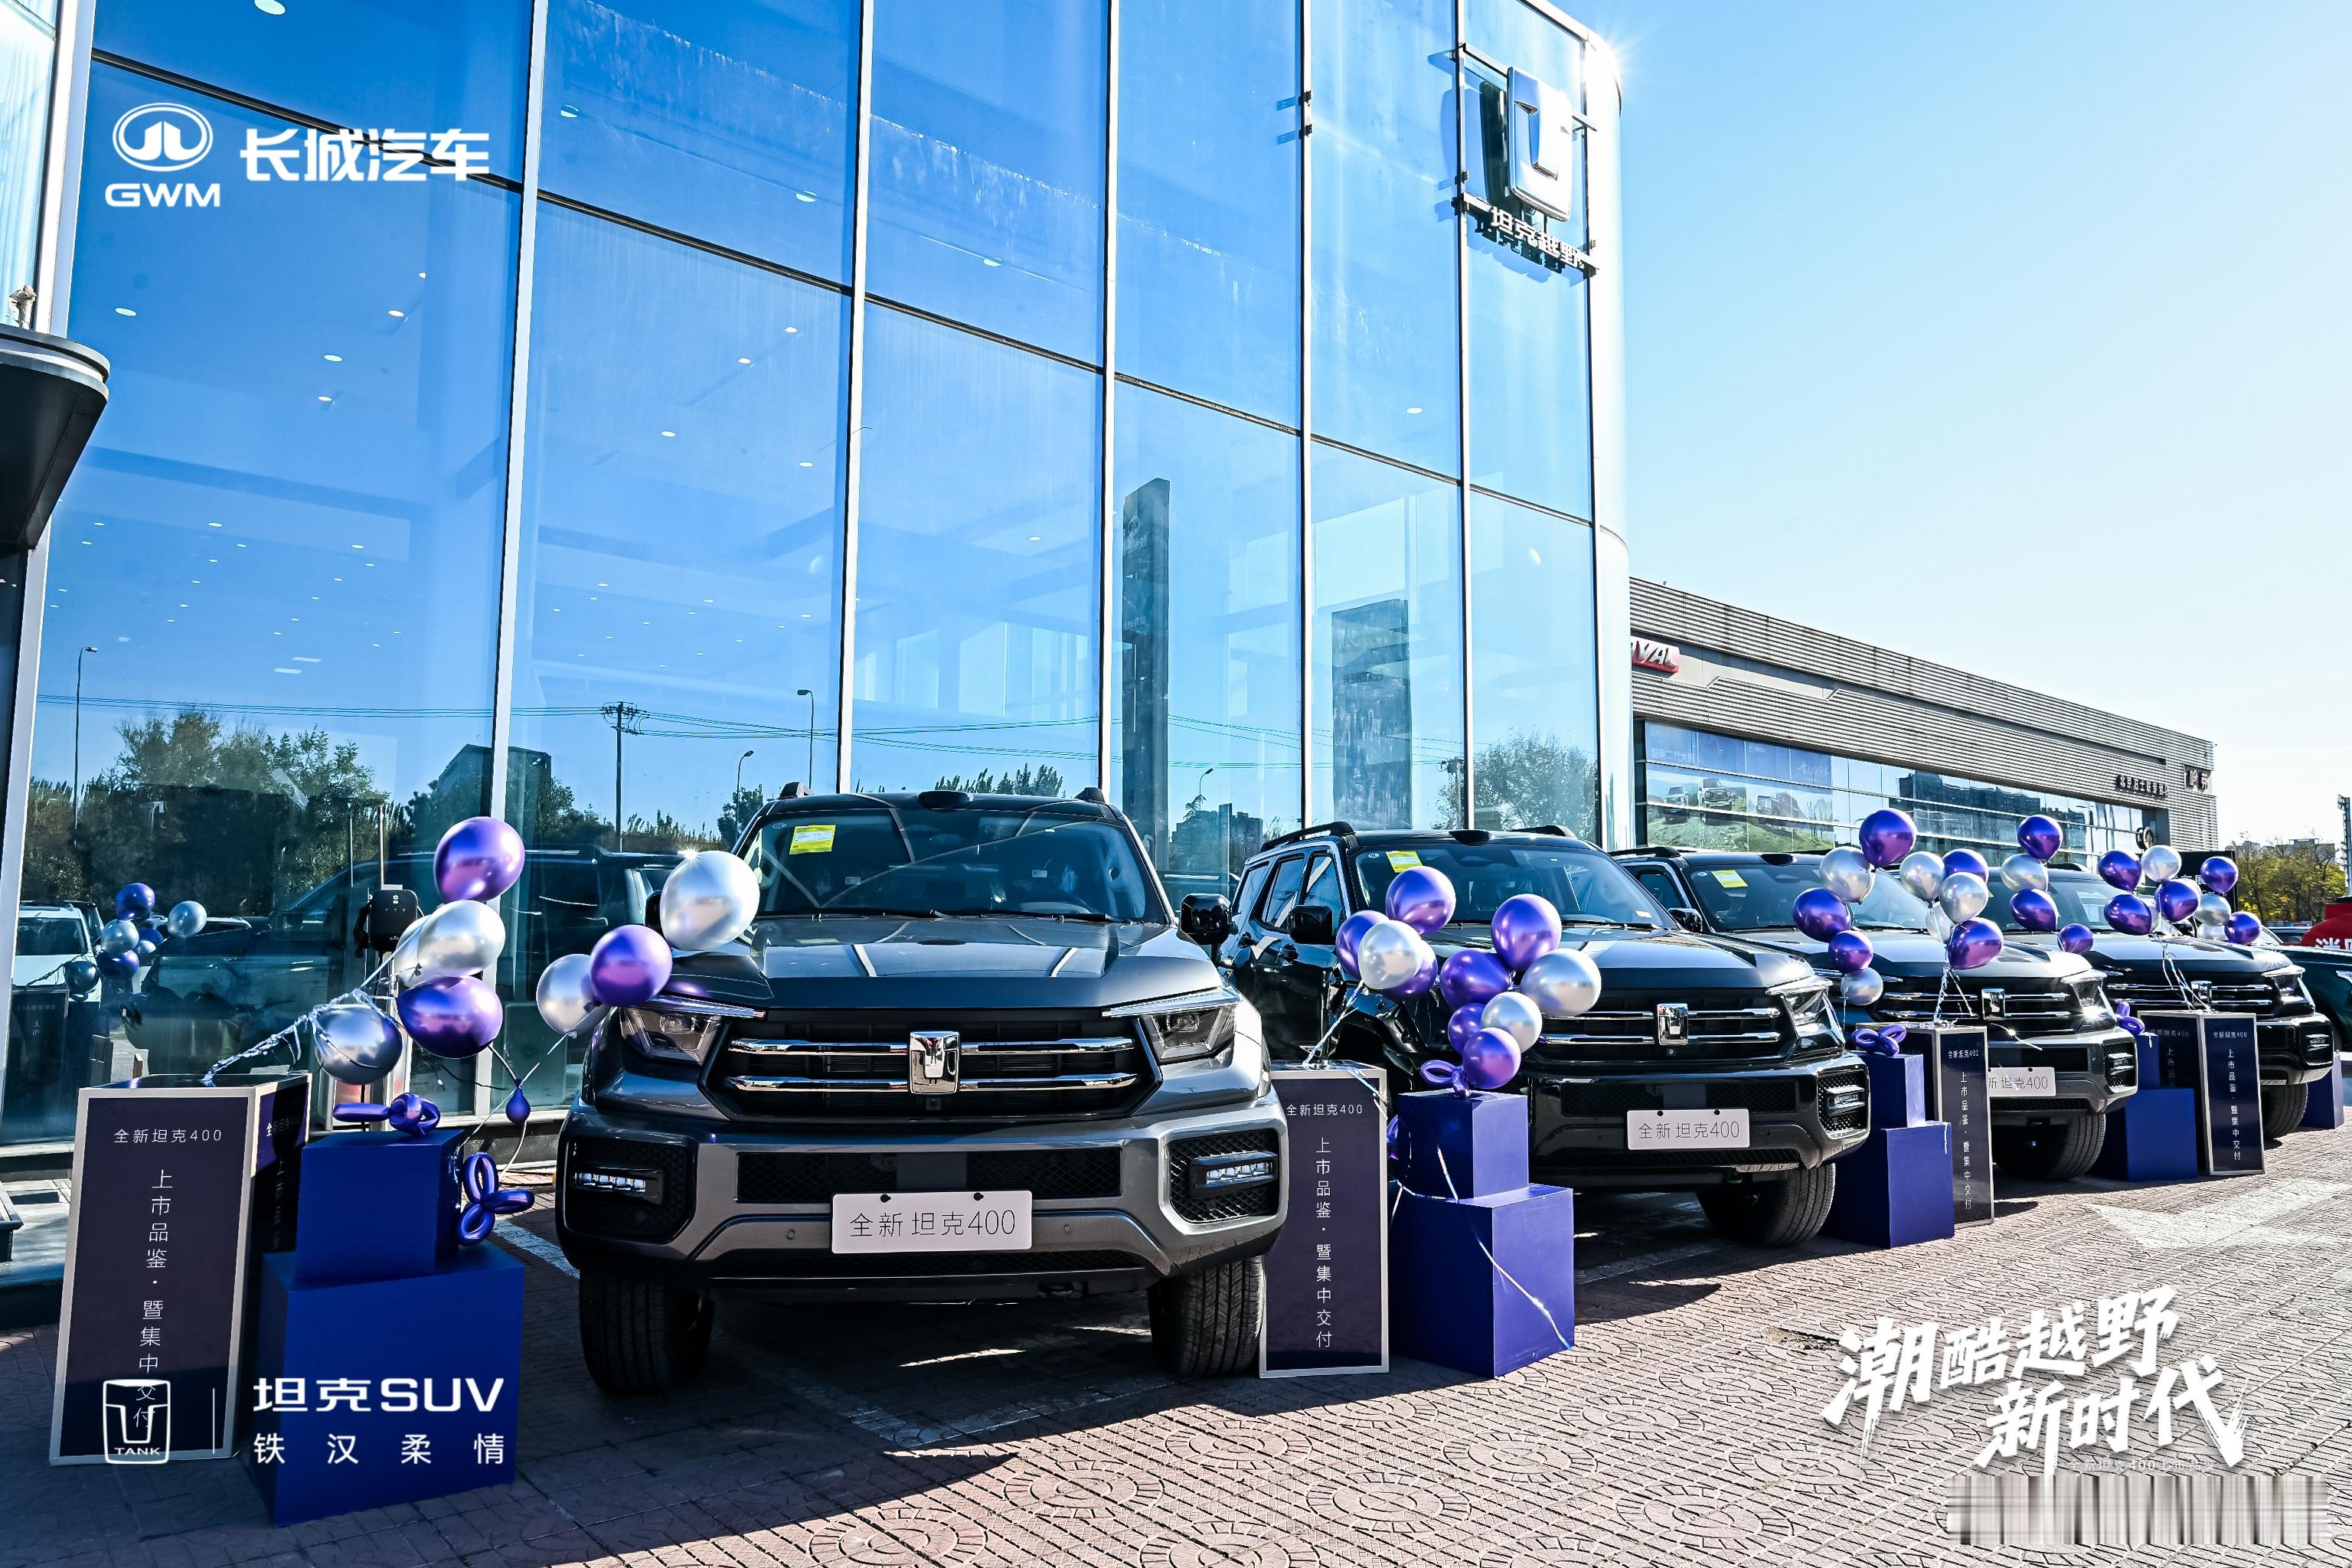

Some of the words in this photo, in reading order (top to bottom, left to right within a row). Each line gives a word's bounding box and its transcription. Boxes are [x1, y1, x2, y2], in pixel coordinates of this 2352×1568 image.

[1491, 206, 1585, 269] 坦克越野
[1631, 640, 1678, 668] VAL
[1285, 1102, 1364, 1116] 全新坦克400
[114, 1129, 222, 1145] 全新坦克400
[1638, 1121, 1740, 1139] 全新坦克400
[850, 1210, 1015, 1238] 全新坦克400
